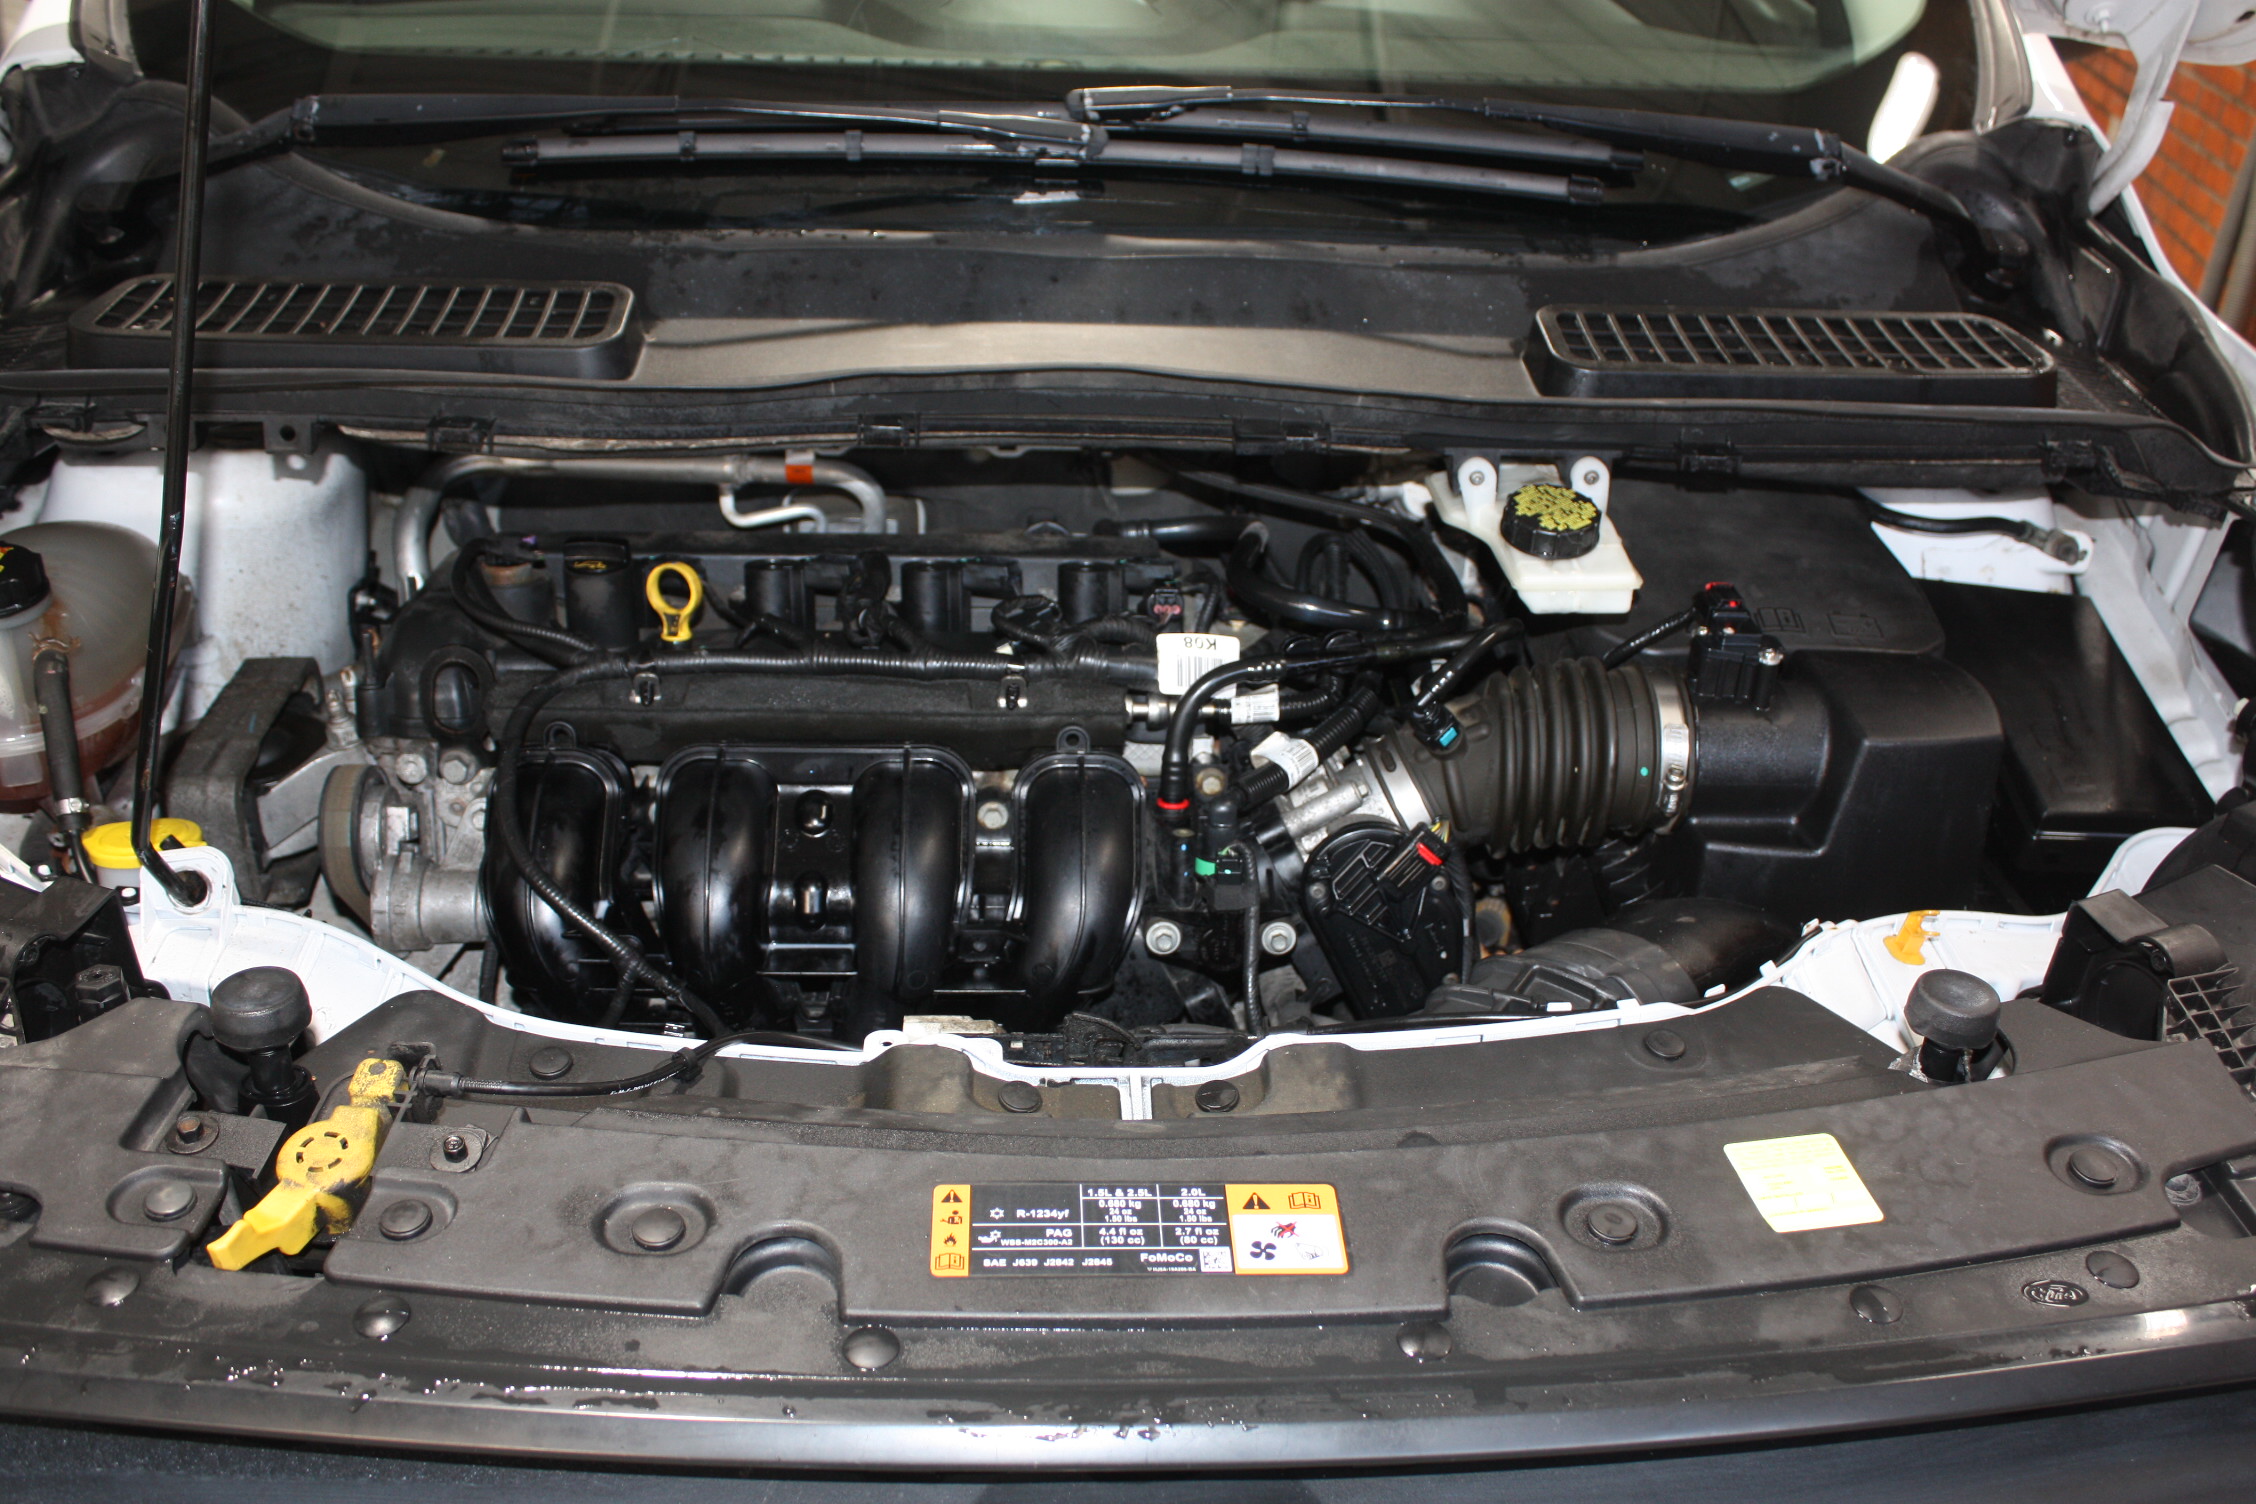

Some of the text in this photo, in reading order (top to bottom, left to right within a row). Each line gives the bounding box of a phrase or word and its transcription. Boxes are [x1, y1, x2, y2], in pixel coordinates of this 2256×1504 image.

[1183, 636, 1217, 651] K08
[1087, 1188, 1152, 1197] 1.5L & 2.5L
[1180, 1188, 1206, 1197] 2.0L
[1128, 1200, 1142, 1209] kg
[1202, 1200, 1216, 1209] kg
[1016, 1208, 1070, 1220] R-1234yf
[1124, 1215, 1138, 1223] lbs
[1199, 1215, 1213, 1223] lbs
[1045, 1228, 1073, 1238] PAG
[1099, 1227, 1117, 1235] 4.4
[1119, 1227, 1127, 1235] fl
[1174, 1227, 1192, 1235] 2.7
[1194, 1227, 1203, 1235] fl
[1100, 1236, 1145, 1246] (130 cc)
[1200, 1236, 1218, 1246] cc)
[1140, 1252, 1194, 1263] FoMoCo
[983, 1258, 1007, 1267] SAE
